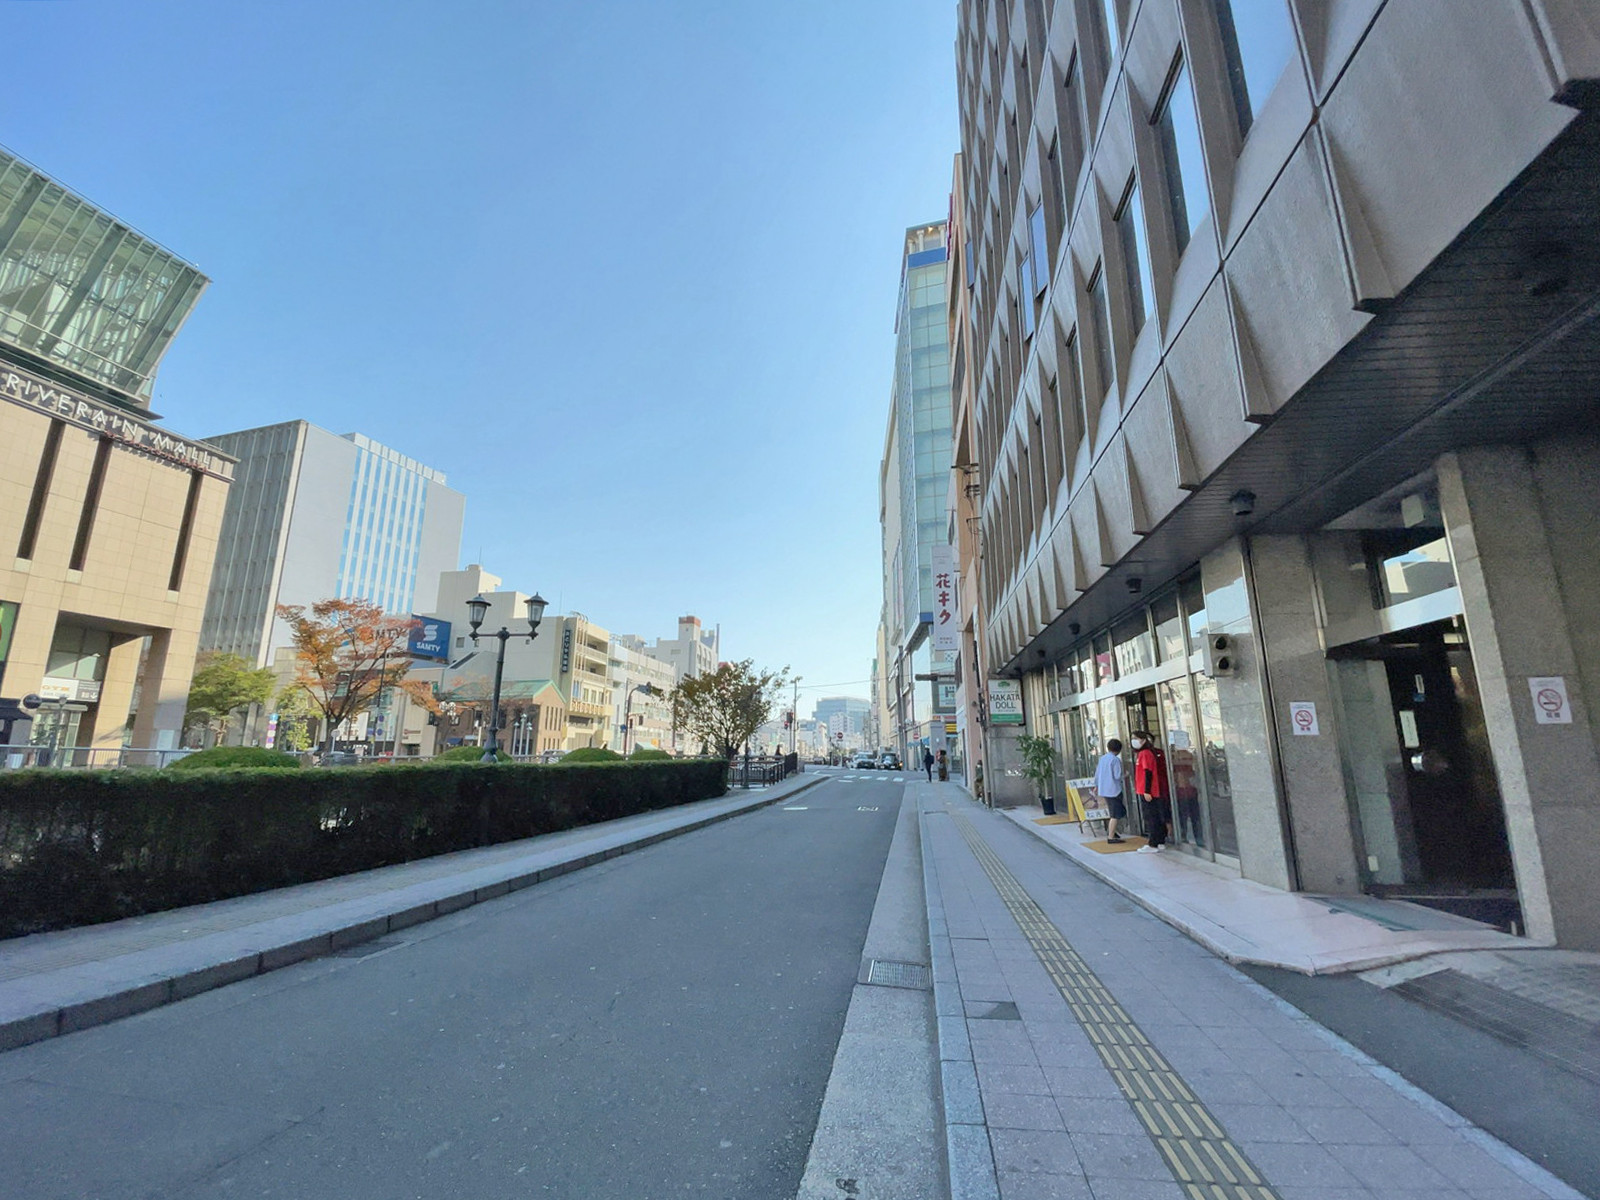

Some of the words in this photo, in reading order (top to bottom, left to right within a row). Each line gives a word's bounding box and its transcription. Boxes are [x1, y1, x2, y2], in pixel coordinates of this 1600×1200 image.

[6, 373, 138, 437] RIVERAIN
[153, 433, 211, 465] MALL
[936, 573, 951, 625] 花キク
[416, 642, 441, 653] SAMTY
[989, 693, 1021, 702] HAKATA
[995, 701, 1017, 709] DOLL
